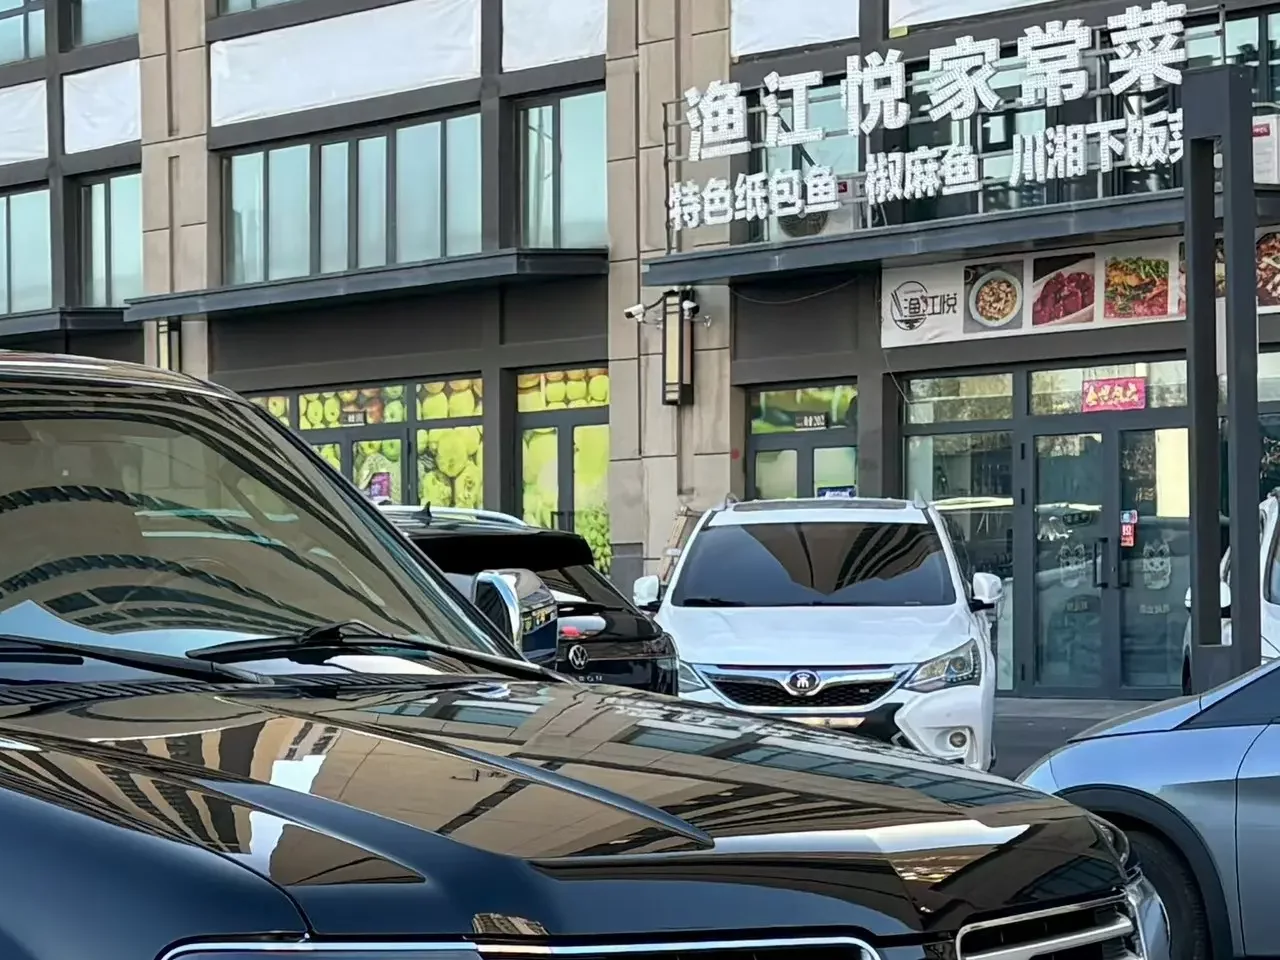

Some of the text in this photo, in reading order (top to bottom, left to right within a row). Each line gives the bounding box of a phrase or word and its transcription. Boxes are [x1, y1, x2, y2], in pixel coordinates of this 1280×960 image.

[684, 0, 1187, 161] 渔江悦家常菜
[669, 165, 842, 231] 特色纸包鱼
[865, 145, 982, 205] 椒麻鱼
